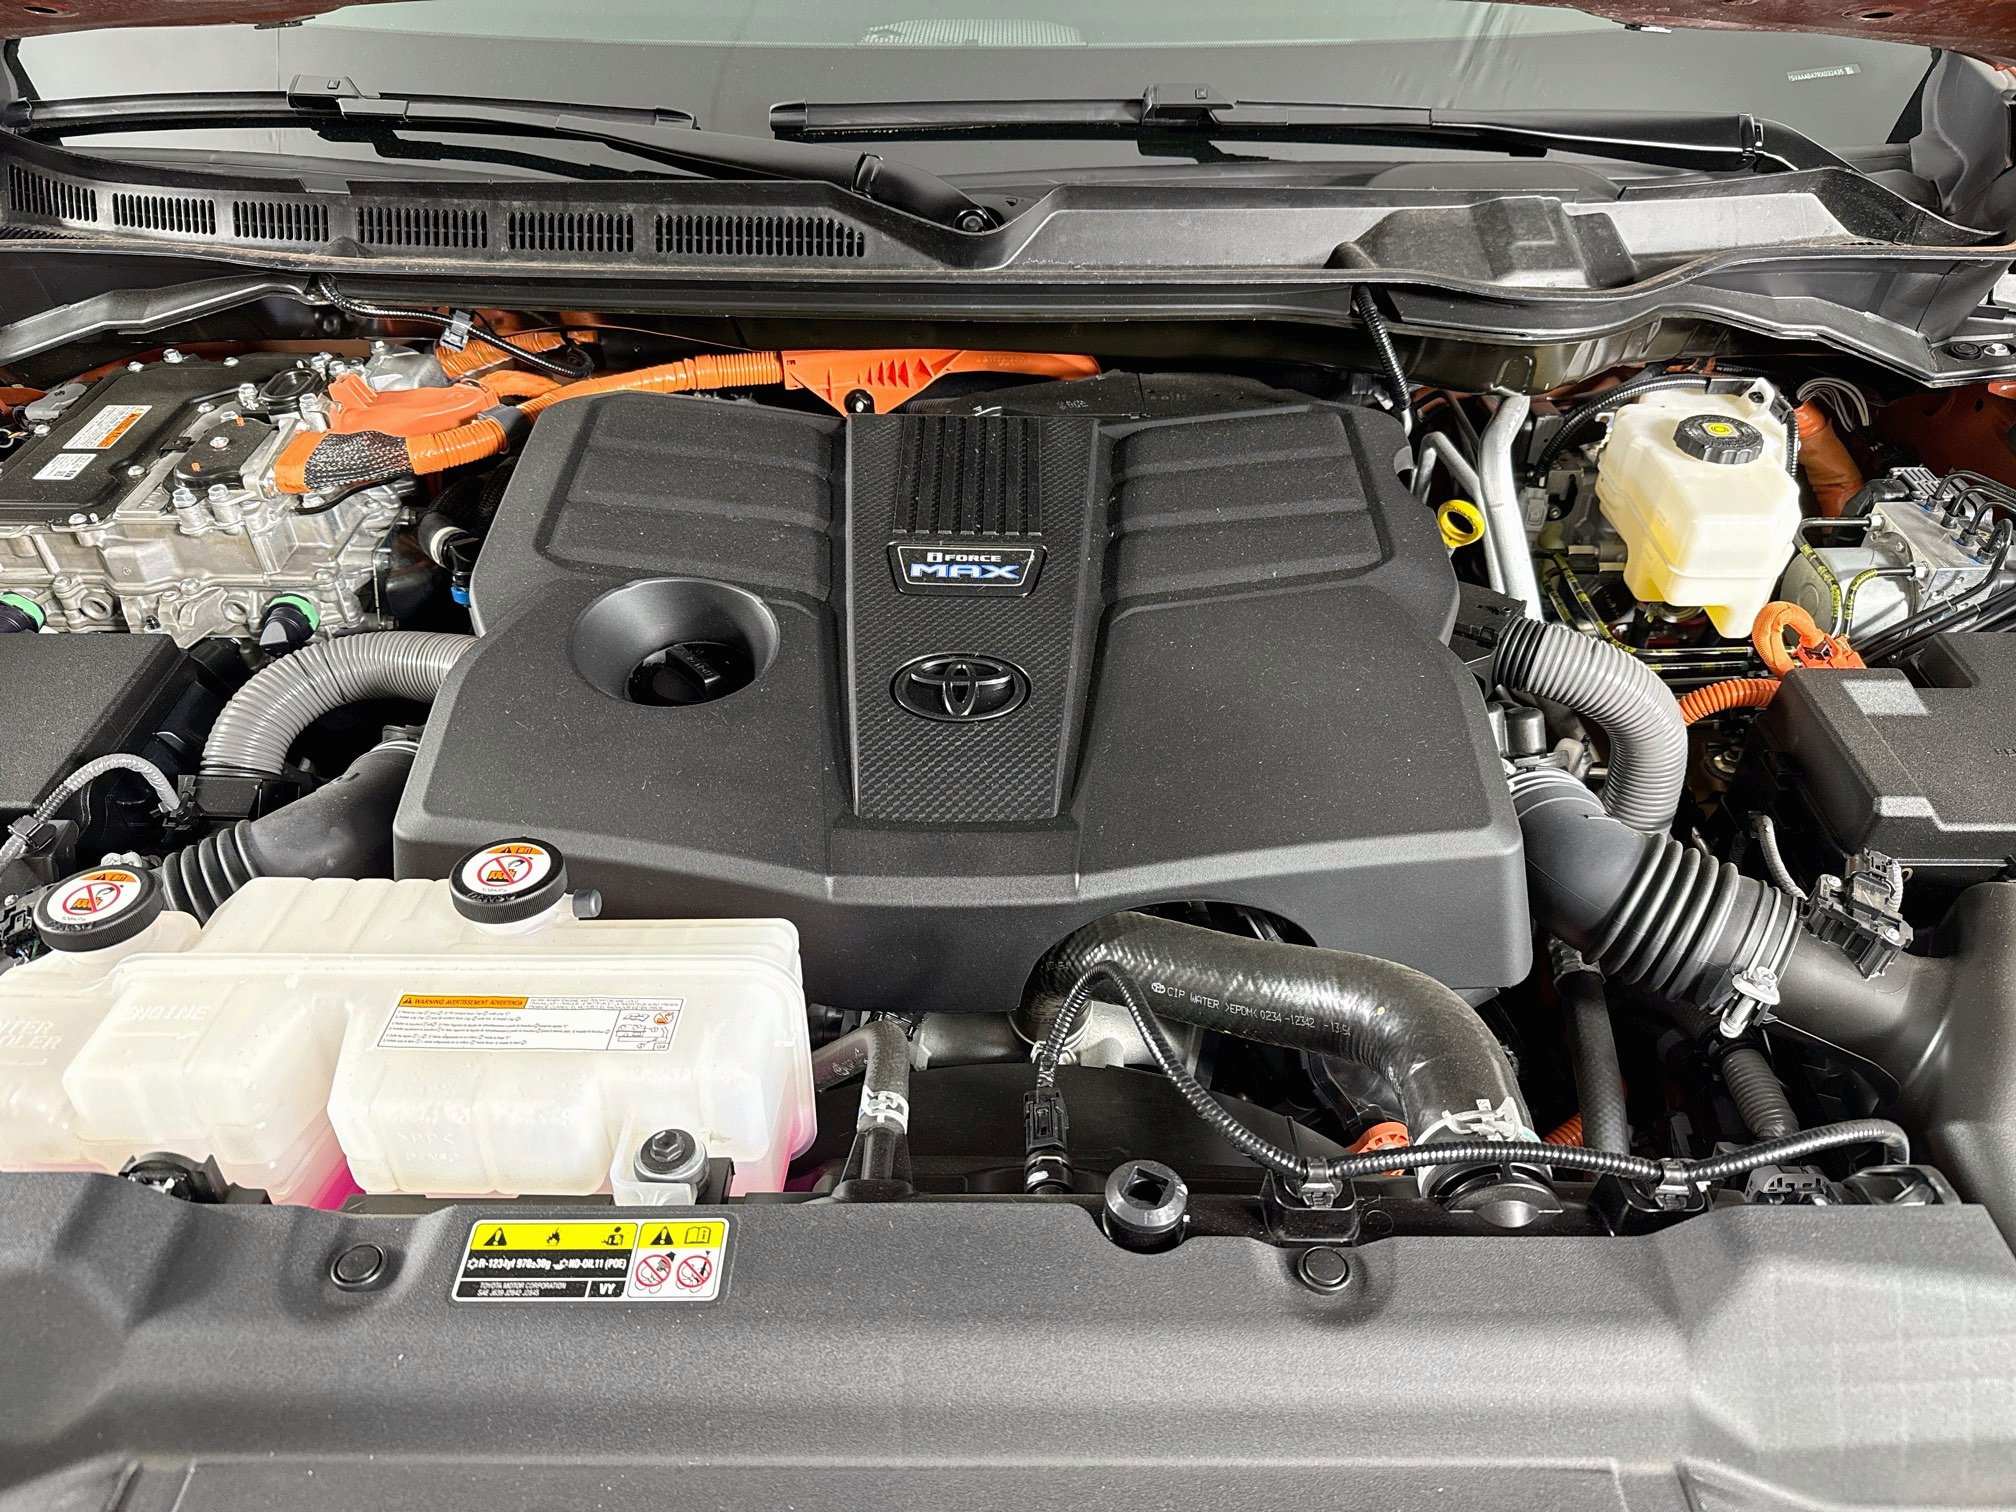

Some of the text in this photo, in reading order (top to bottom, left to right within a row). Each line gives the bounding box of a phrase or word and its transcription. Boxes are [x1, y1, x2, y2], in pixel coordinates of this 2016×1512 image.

[944, 554, 1001, 562] FORCE
[910, 563, 1020, 579] MAX
[1166, 986, 1185, 998] CIP
[1190, 992, 1219, 1009] WATER
[605, 1258, 627, 1270] (POE)
[600, 1283, 616, 1294] VY
